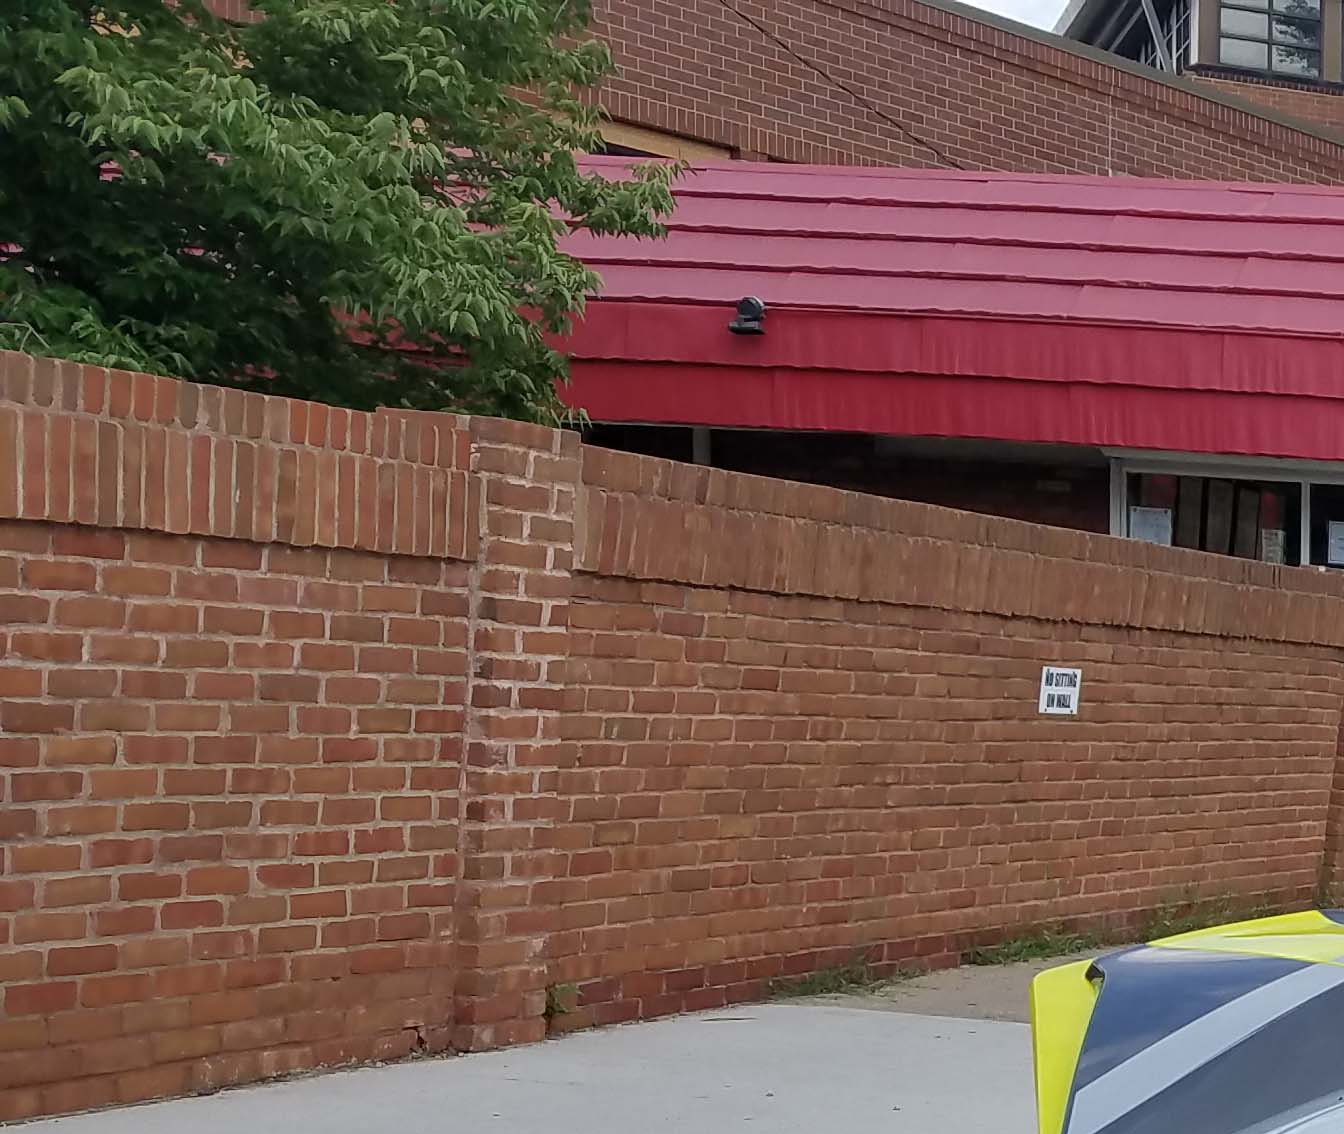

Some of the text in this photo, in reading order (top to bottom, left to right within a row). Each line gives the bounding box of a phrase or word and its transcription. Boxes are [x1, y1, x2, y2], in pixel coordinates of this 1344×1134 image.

[1045, 669, 1078, 688] NO SITTING
[1046, 693, 1071, 708] ON WALL
